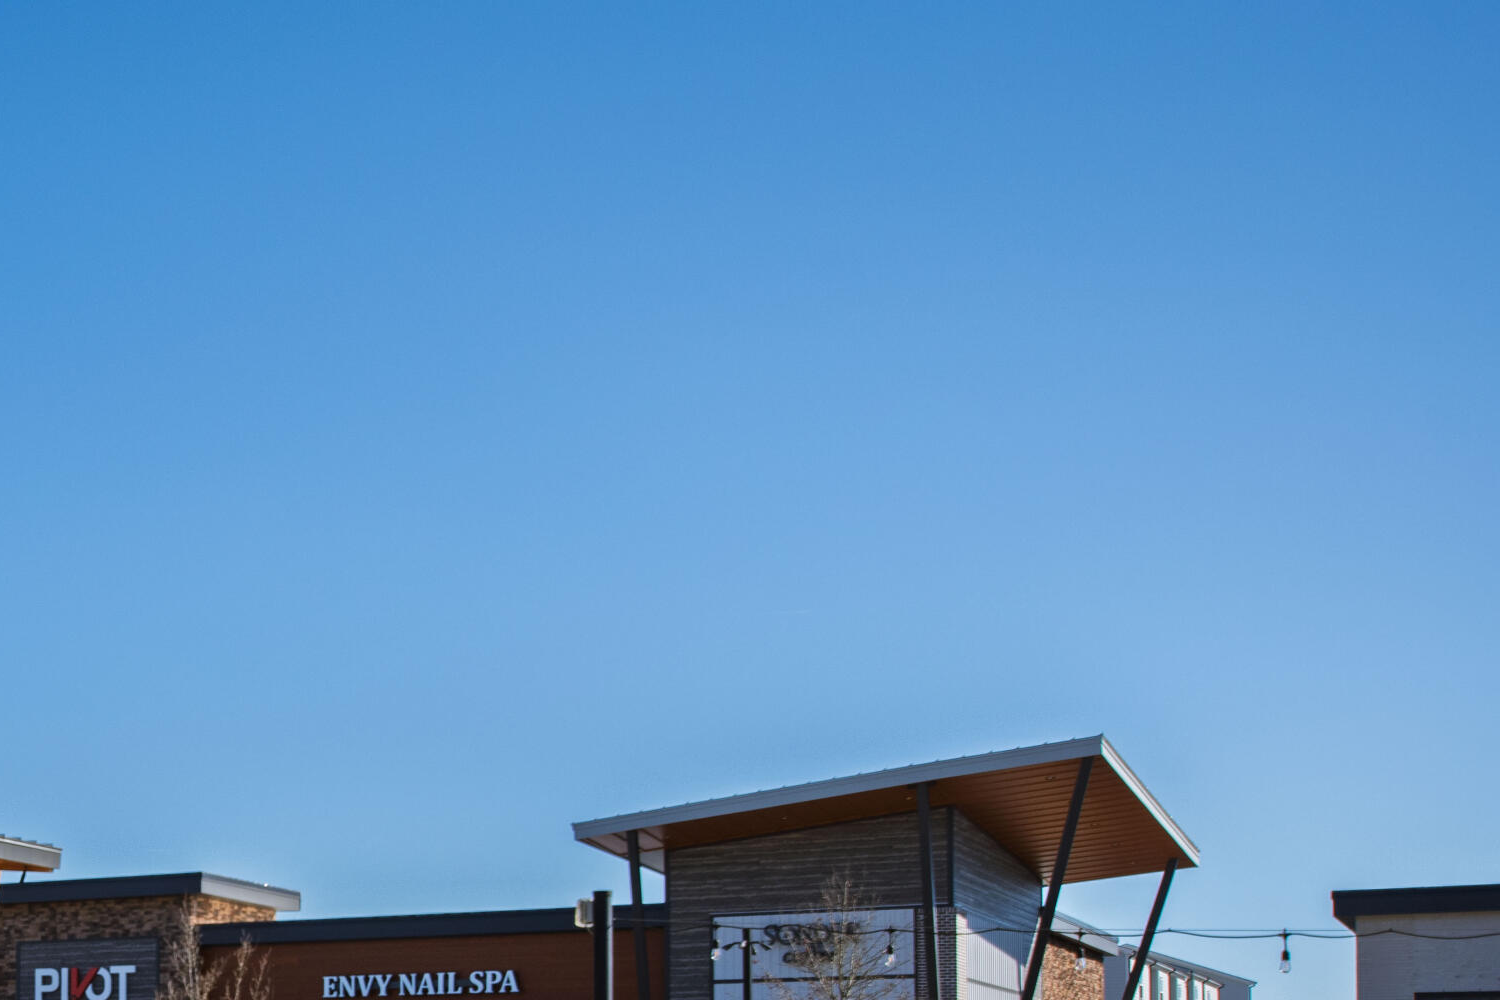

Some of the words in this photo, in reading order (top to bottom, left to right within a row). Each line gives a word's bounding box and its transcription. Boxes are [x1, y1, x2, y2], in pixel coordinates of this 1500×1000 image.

[322, 974, 392, 998] ENVY
[398, 972, 463, 996] NAIL
[469, 970, 520, 994] SPA
